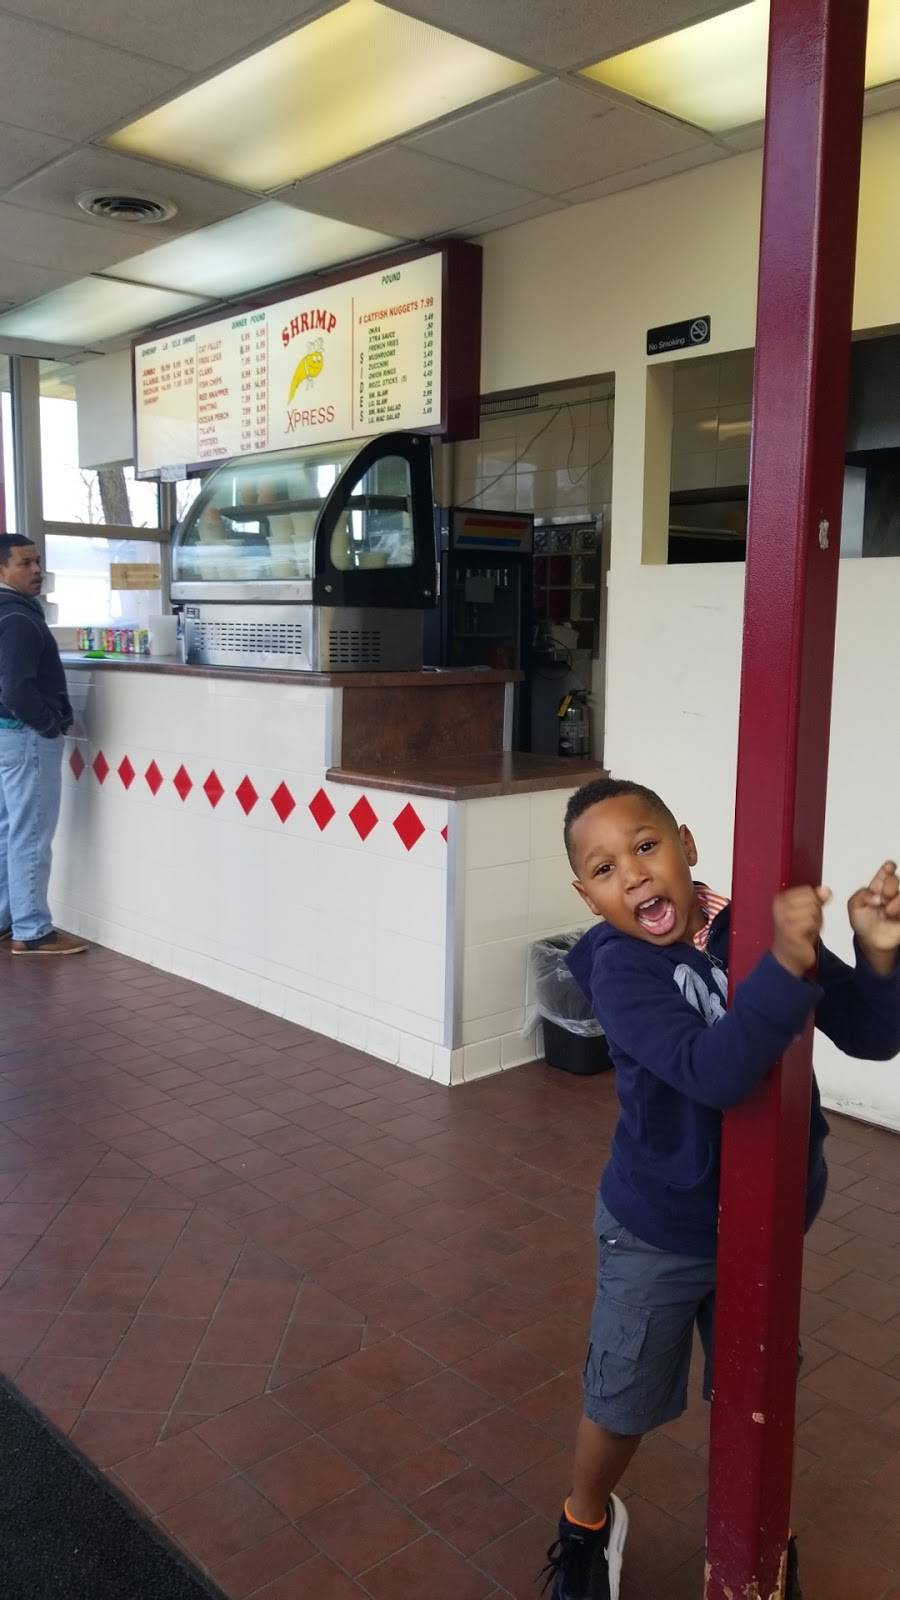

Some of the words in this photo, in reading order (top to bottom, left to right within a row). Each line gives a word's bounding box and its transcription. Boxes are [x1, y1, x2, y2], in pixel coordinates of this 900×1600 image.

[381, 272, 400, 285] POUND
[364, 309, 388, 324] CATFISH
[389, 300, 418, 317] NUGGETS
[420, 296, 434, 308] 7.99
[282, 309, 336, 348] SHRIMP
[382, 331, 395, 340] SAUCE
[368, 343, 386, 352] FRENCH
[387, 339, 398, 347] FRIES
[659, 337, 685, 349] Smoking
[368, 349, 395, 360] MUSHROOMS
[368, 360, 388, 370] ZUCCHINI
[383, 368, 396, 376] RINGS
[387, 403, 401, 412] SALAD
[284, 405, 335, 434] XPRESS
[386, 412, 400, 421] SALAD
